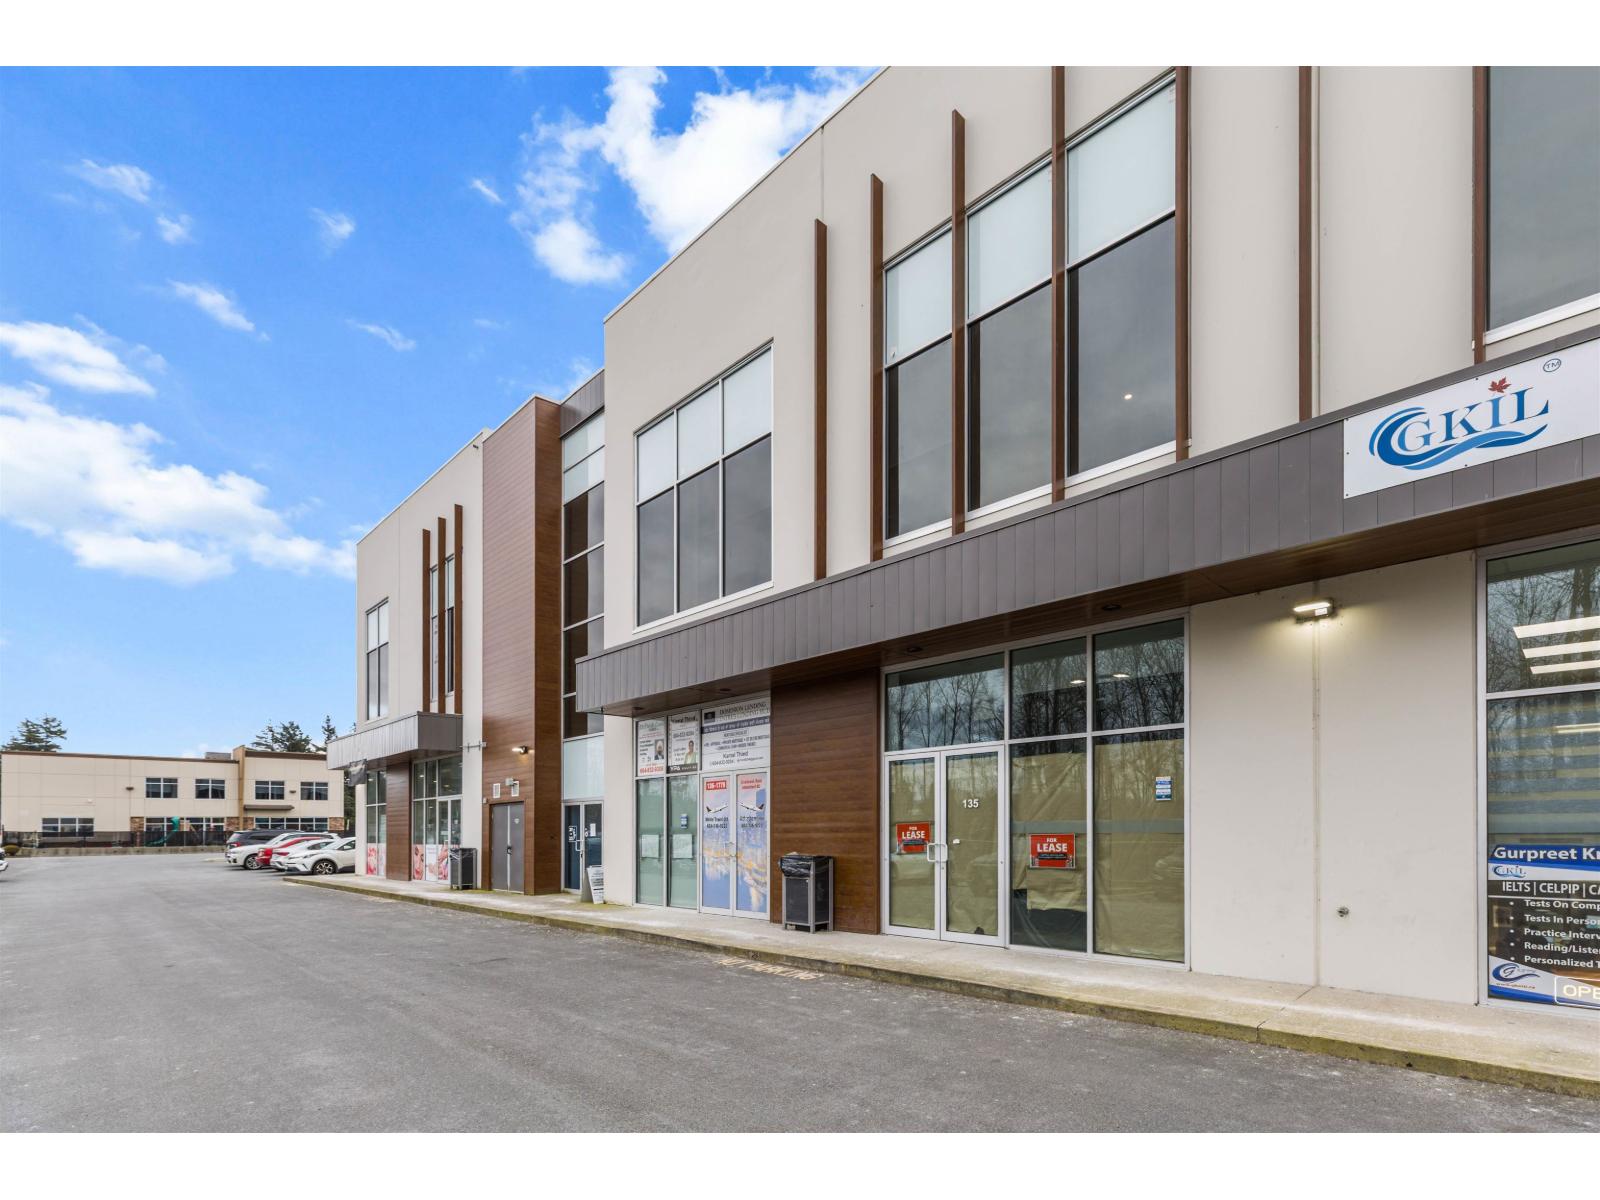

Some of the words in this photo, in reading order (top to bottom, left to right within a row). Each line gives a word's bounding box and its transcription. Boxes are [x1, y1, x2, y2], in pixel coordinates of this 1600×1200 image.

[1398, 387, 1549, 452] GKIL
[962, 799, 979, 809] 135
[902, 831, 926, 840] LEASE
[1036, 842, 1068, 853] LEASE
[1493, 847, 1578, 862] Gurpreet
[1502, 881, 1531, 893] IELTS
[1540, 883, 1580, 894] CELPIP
[1524, 899, 1551, 908] Tests
[1553, 900, 1569, 909] On
[1524, 914, 1551, 923] Tests
[1553, 915, 1564, 924] In
[1524, 927, 1567, 938] Practice
[1524, 942, 1600, 955] Reading/Liste
[1524, 955, 1594, 969] Personalized
